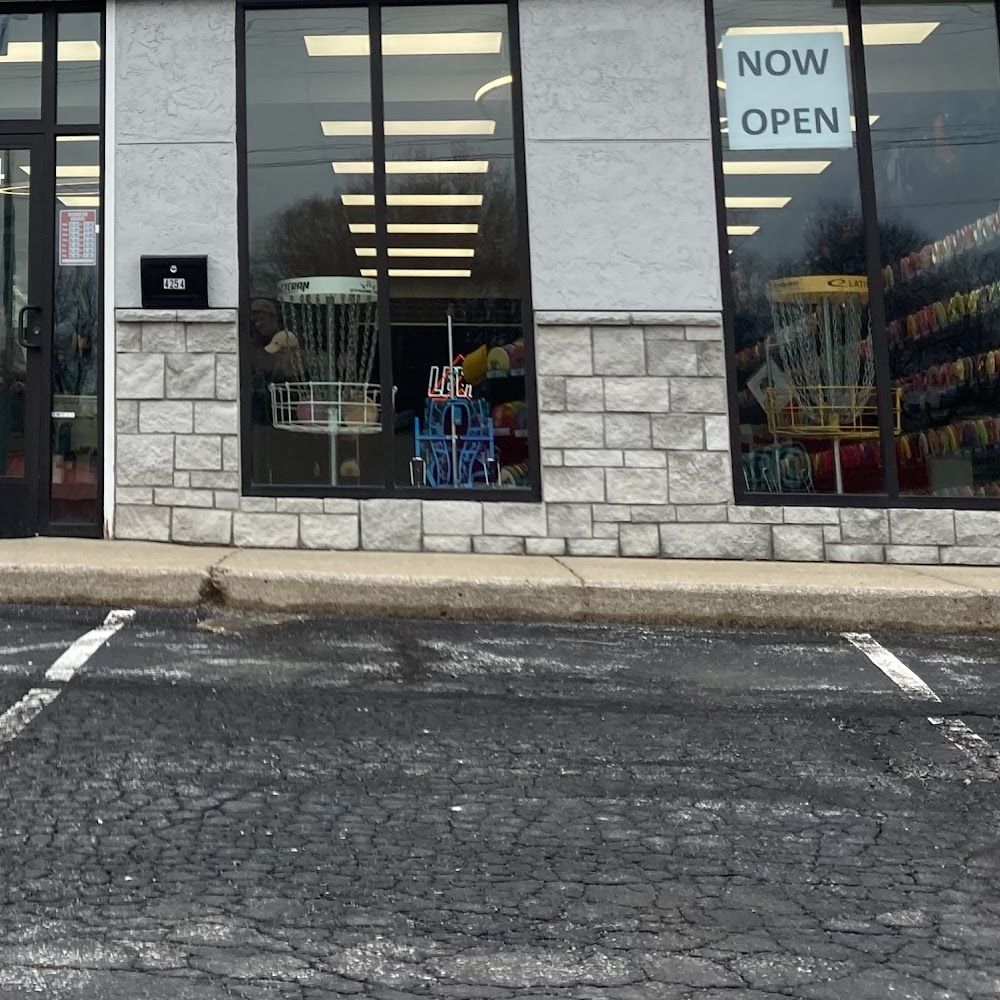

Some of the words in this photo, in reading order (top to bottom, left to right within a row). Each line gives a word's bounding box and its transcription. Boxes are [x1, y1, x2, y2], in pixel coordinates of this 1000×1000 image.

[737, 48, 829, 77] NOW
[741, 107, 839, 136] OPEN
[164, 279, 184, 289] 4254
[280, 281, 310, 292] ETERAN
